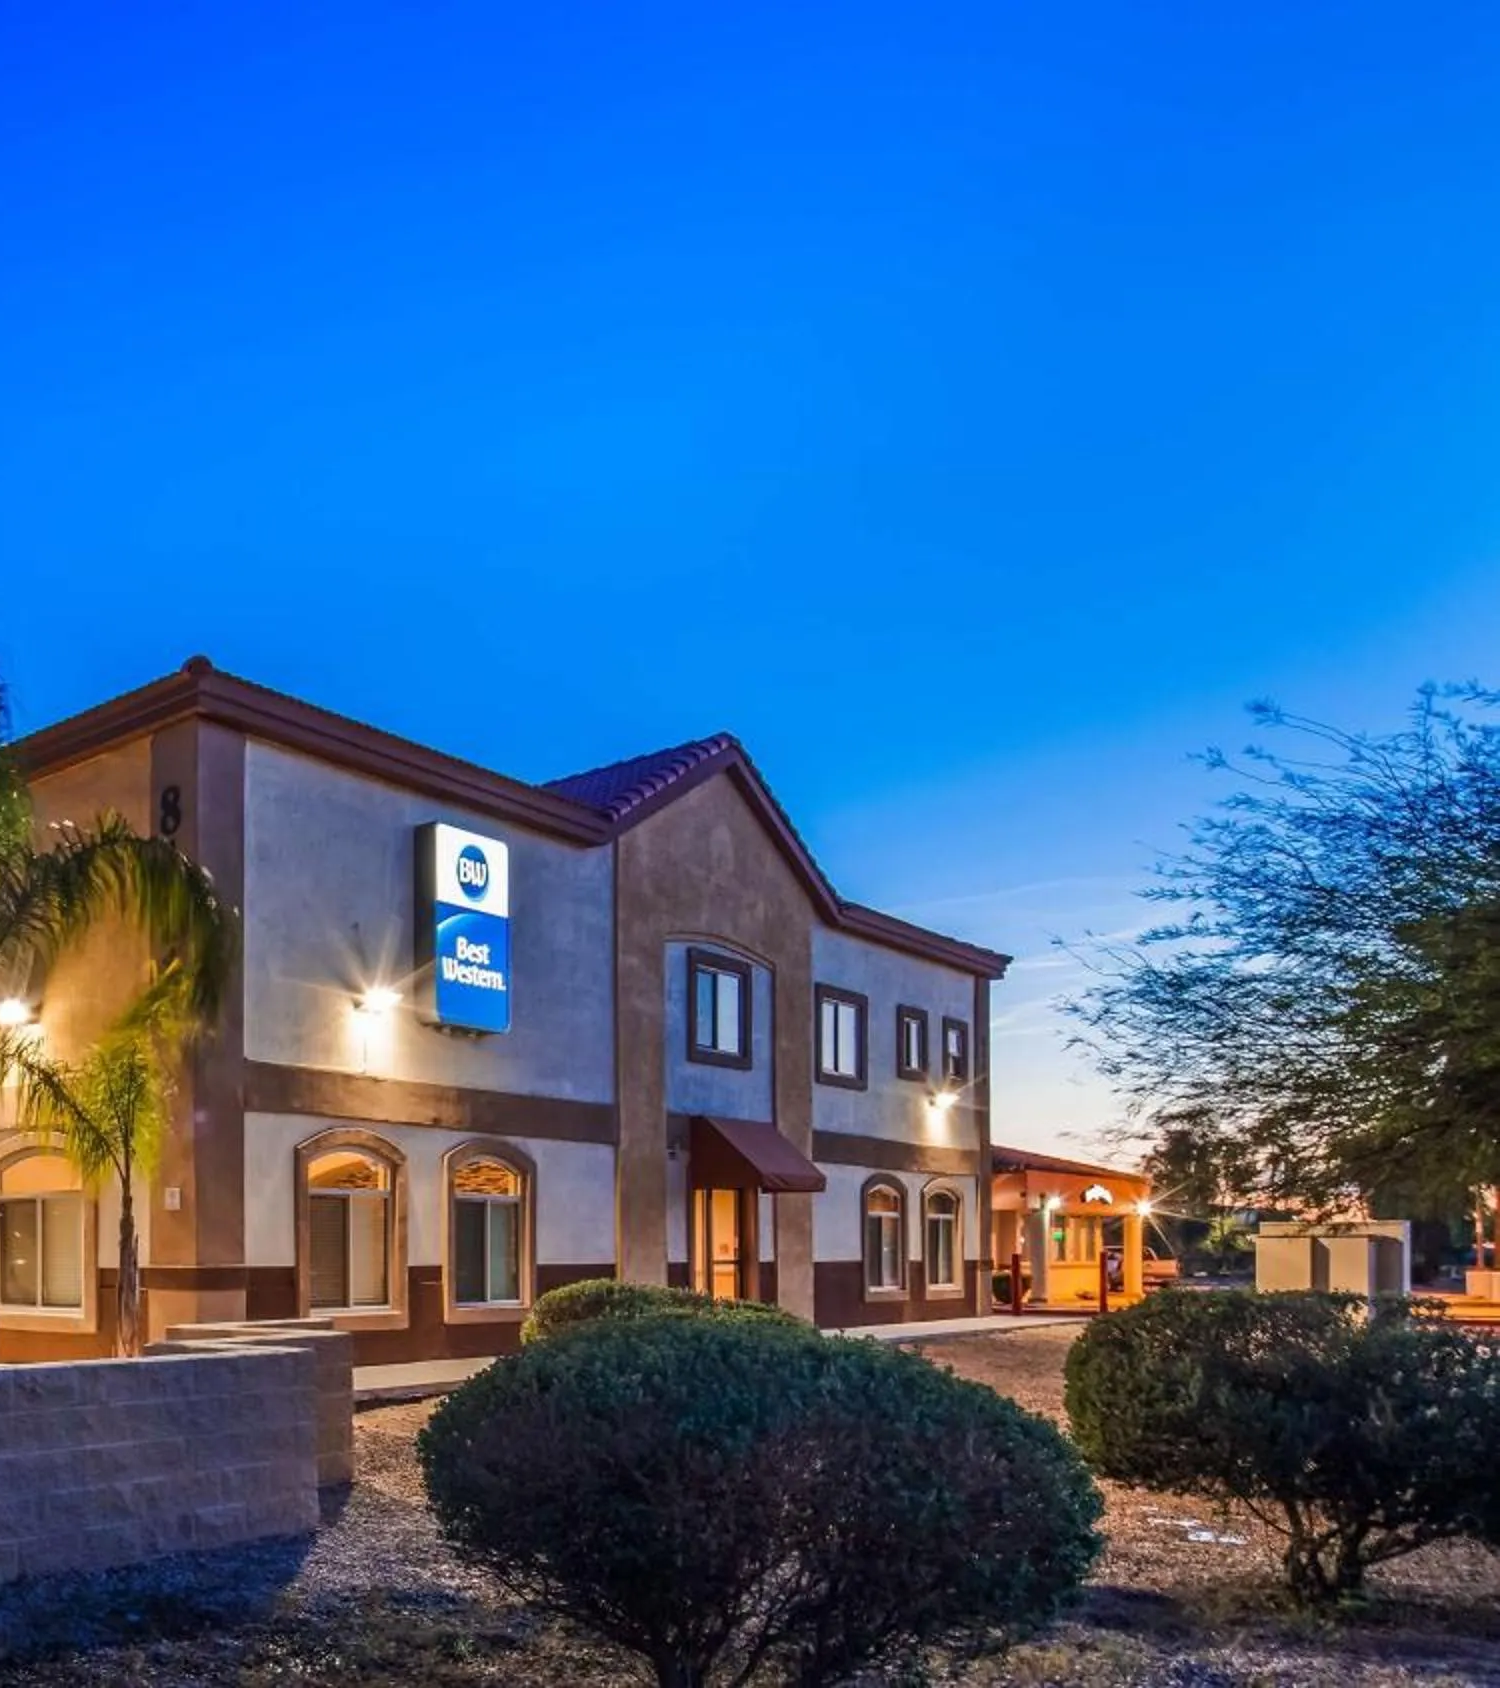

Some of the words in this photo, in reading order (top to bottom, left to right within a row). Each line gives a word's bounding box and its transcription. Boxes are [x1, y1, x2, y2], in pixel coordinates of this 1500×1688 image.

[160, 784, 181, 836] 8
[459, 857, 486, 887] BW
[456, 936, 490, 965] Best
